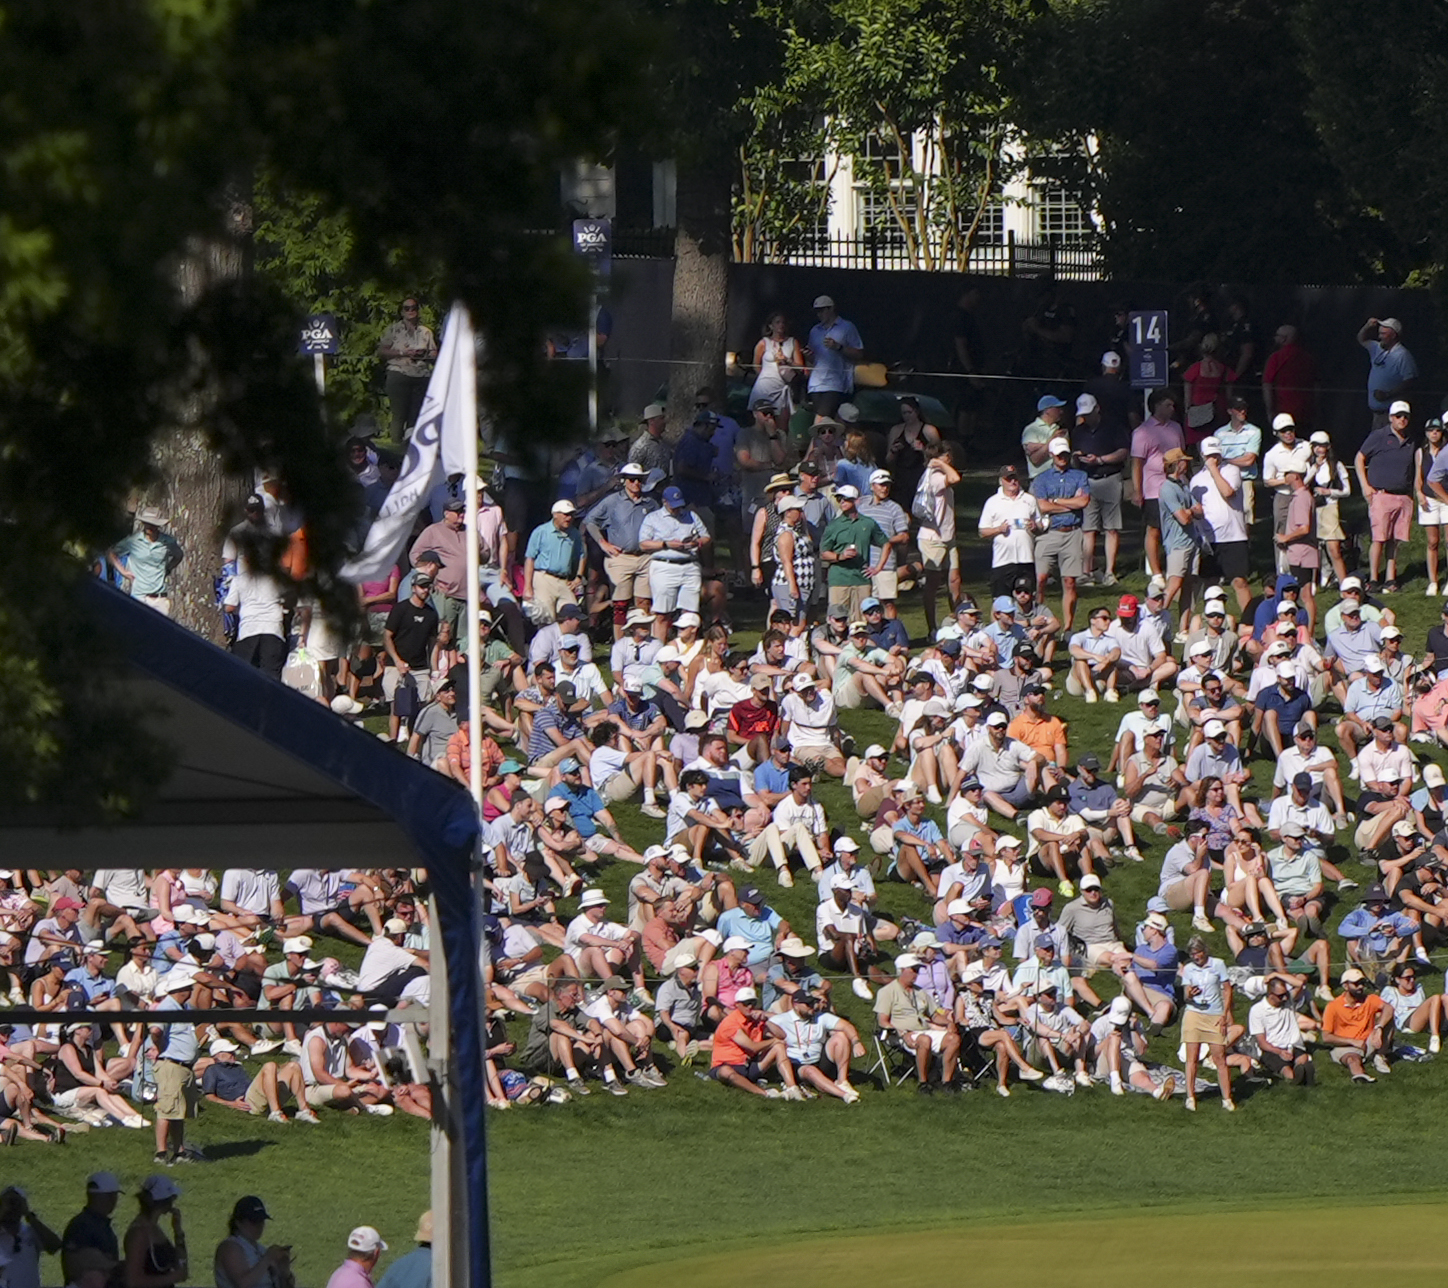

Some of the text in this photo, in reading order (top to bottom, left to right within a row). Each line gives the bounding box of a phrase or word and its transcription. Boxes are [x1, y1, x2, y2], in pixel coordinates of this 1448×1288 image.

[577, 233, 607, 243] PGA
[301, 329, 333, 340] PGA
[1132, 316, 1161, 344] 14
